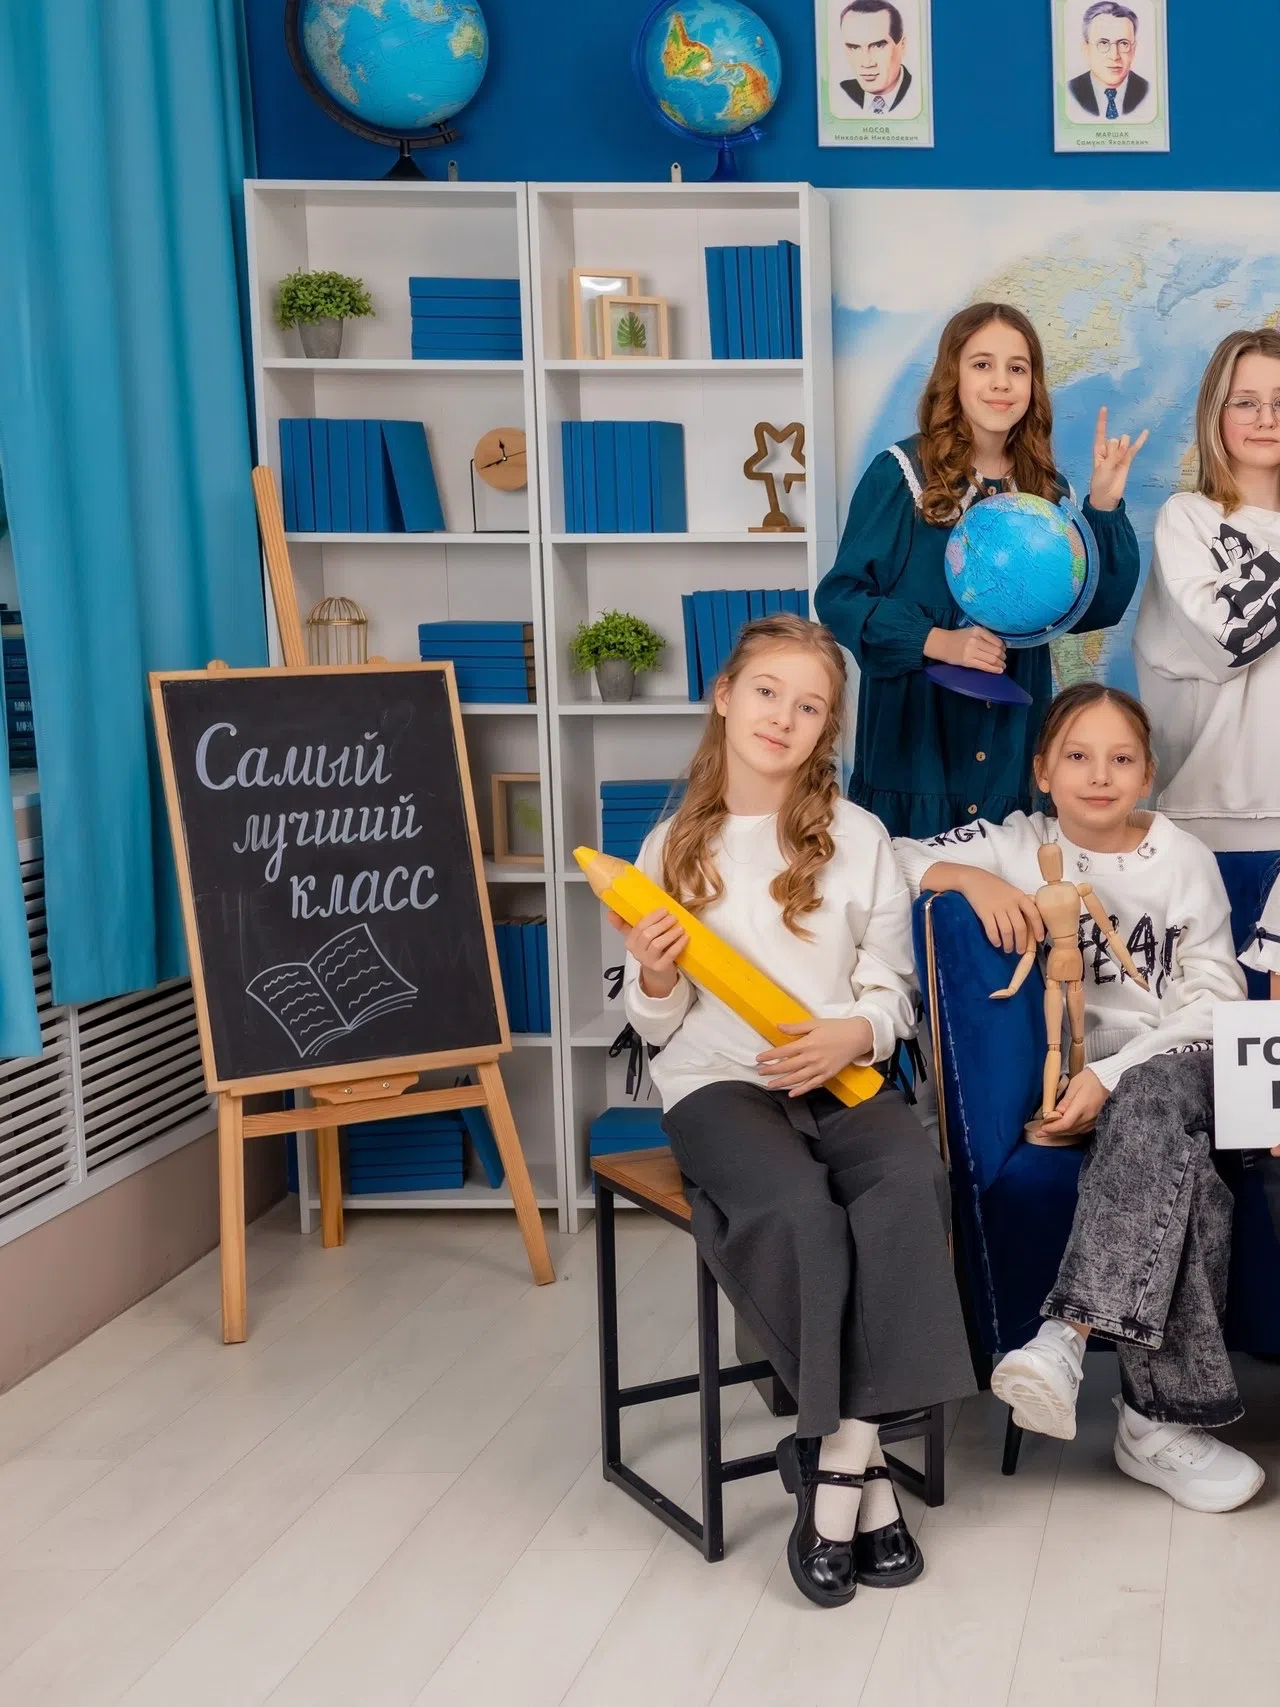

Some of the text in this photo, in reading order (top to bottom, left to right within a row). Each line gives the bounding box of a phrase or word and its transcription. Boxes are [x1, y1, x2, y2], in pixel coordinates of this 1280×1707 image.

[195, 722, 393, 791] Самый
[233, 793, 423, 883] лучший
[290, 865, 439, 919] класс
